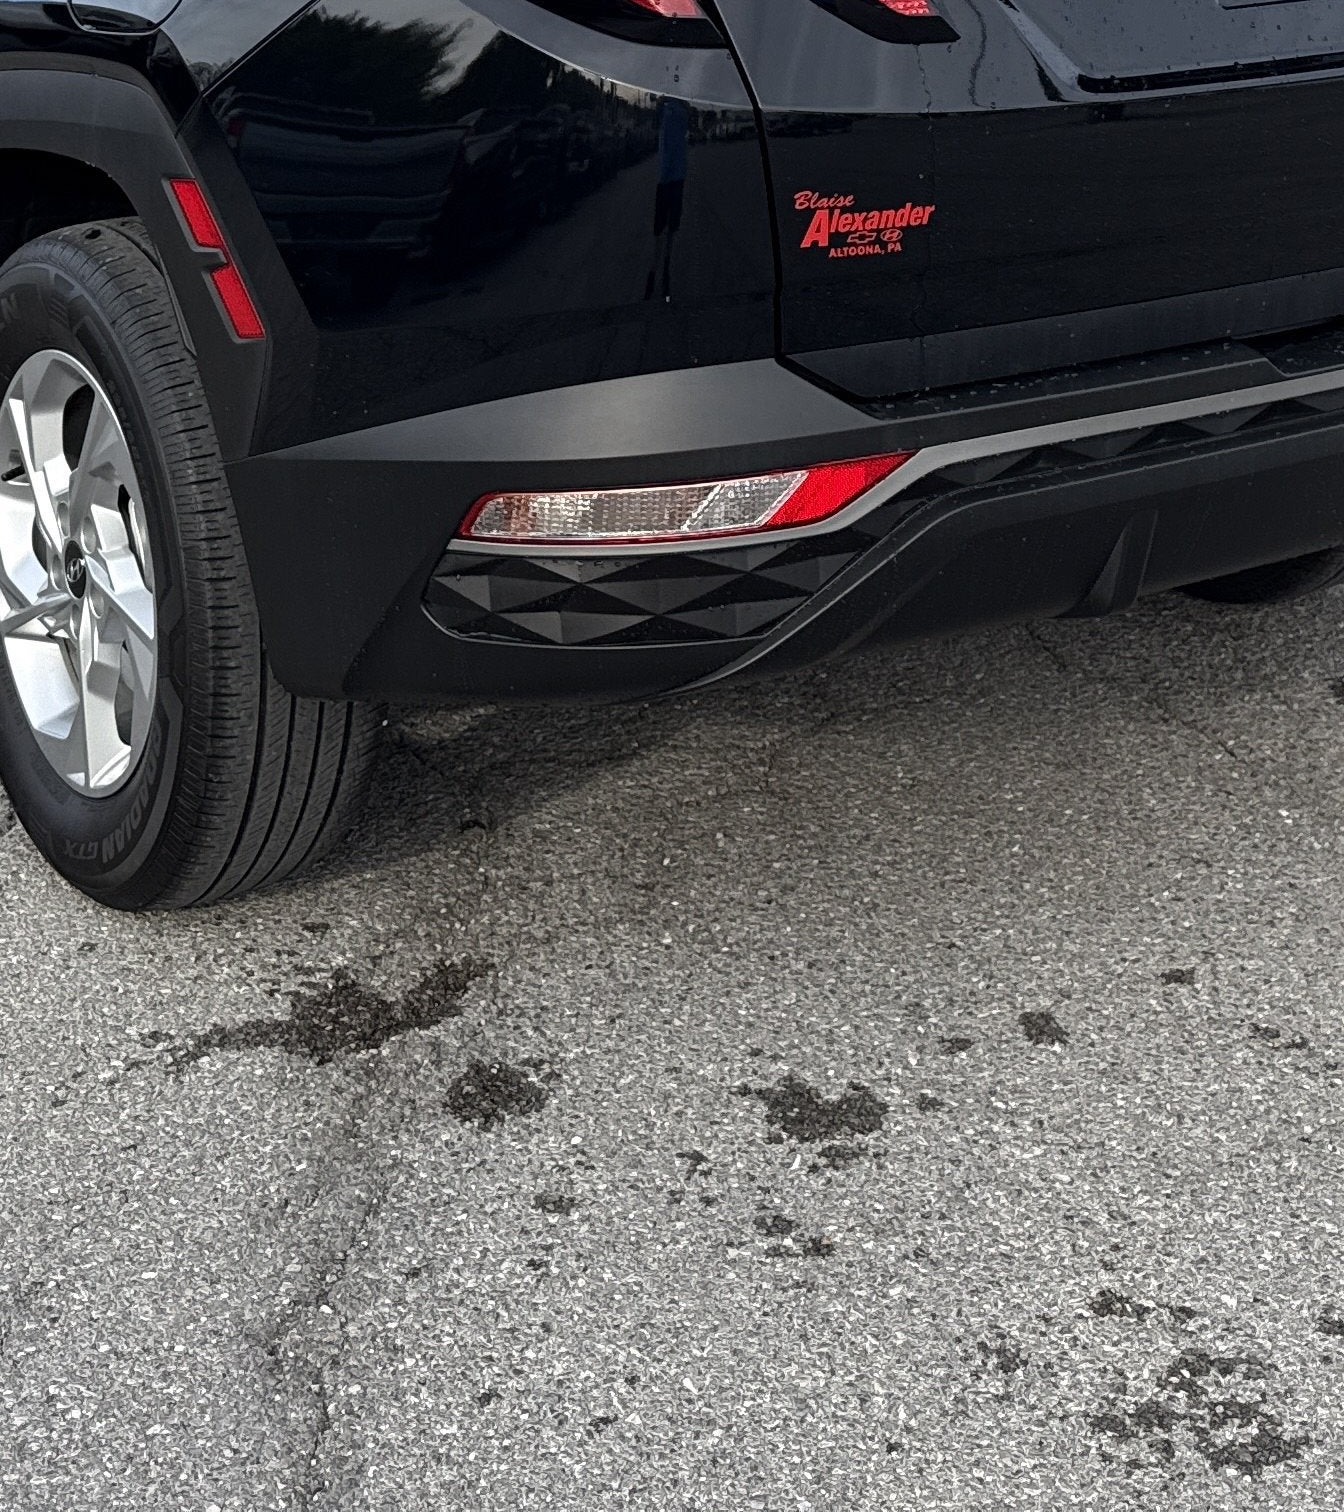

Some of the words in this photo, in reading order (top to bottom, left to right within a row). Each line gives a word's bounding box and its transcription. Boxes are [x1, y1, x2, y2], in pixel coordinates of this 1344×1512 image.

[793, 191, 855, 210] Blaise
[800, 203, 936, 248] Alexander
[828, 243, 885, 258] ALTOONA,
[887, 242, 902, 253] PA
